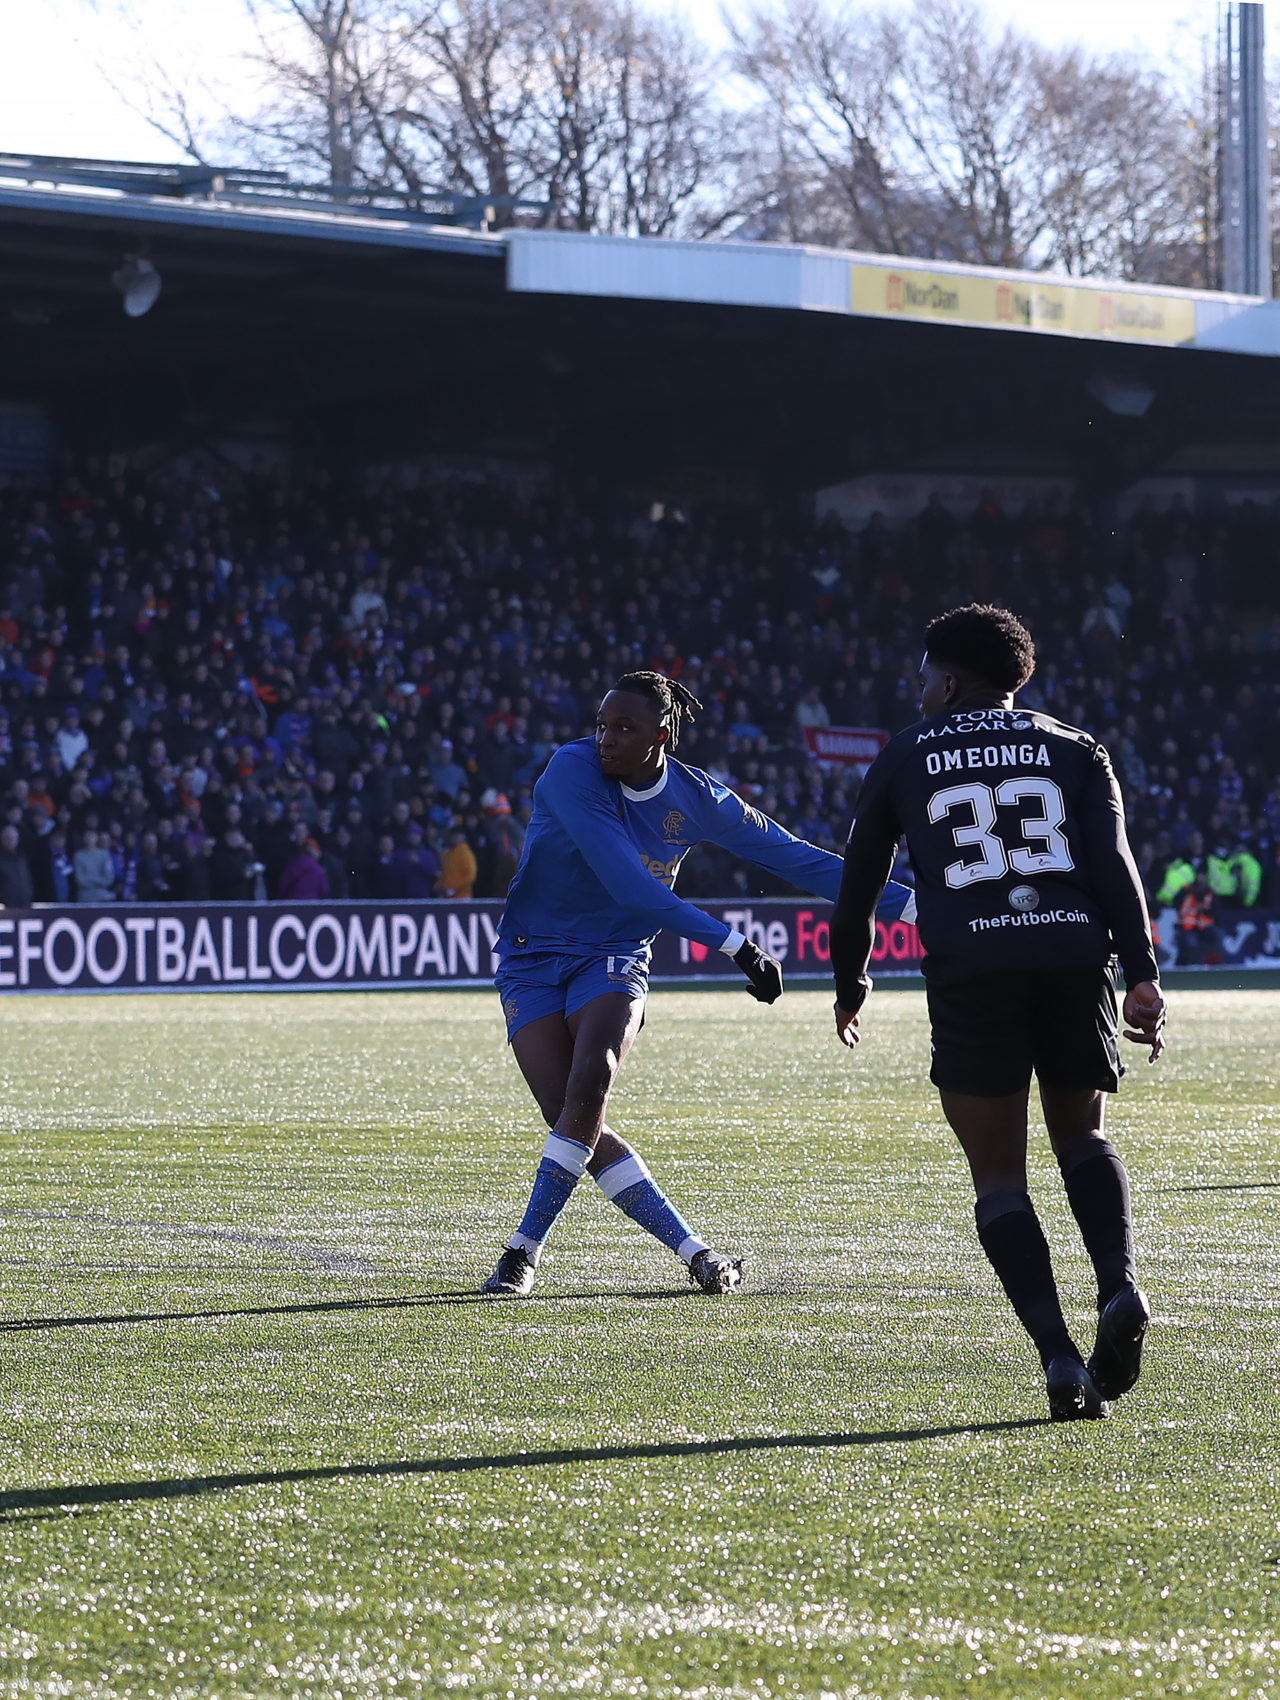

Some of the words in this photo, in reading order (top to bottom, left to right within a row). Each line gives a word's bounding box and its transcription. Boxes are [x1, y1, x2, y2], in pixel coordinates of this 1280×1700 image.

[905, 280, 959, 311] NorDan
[1014, 291, 1065, 321] NoDan
[951, 710, 1024, 722] TONY
[926, 743, 1051, 775] OMEONGA
[926, 776, 1075, 889] 33
[968, 910, 1090, 932] TheFutbolCoin
[606, 955, 638, 975] 17
